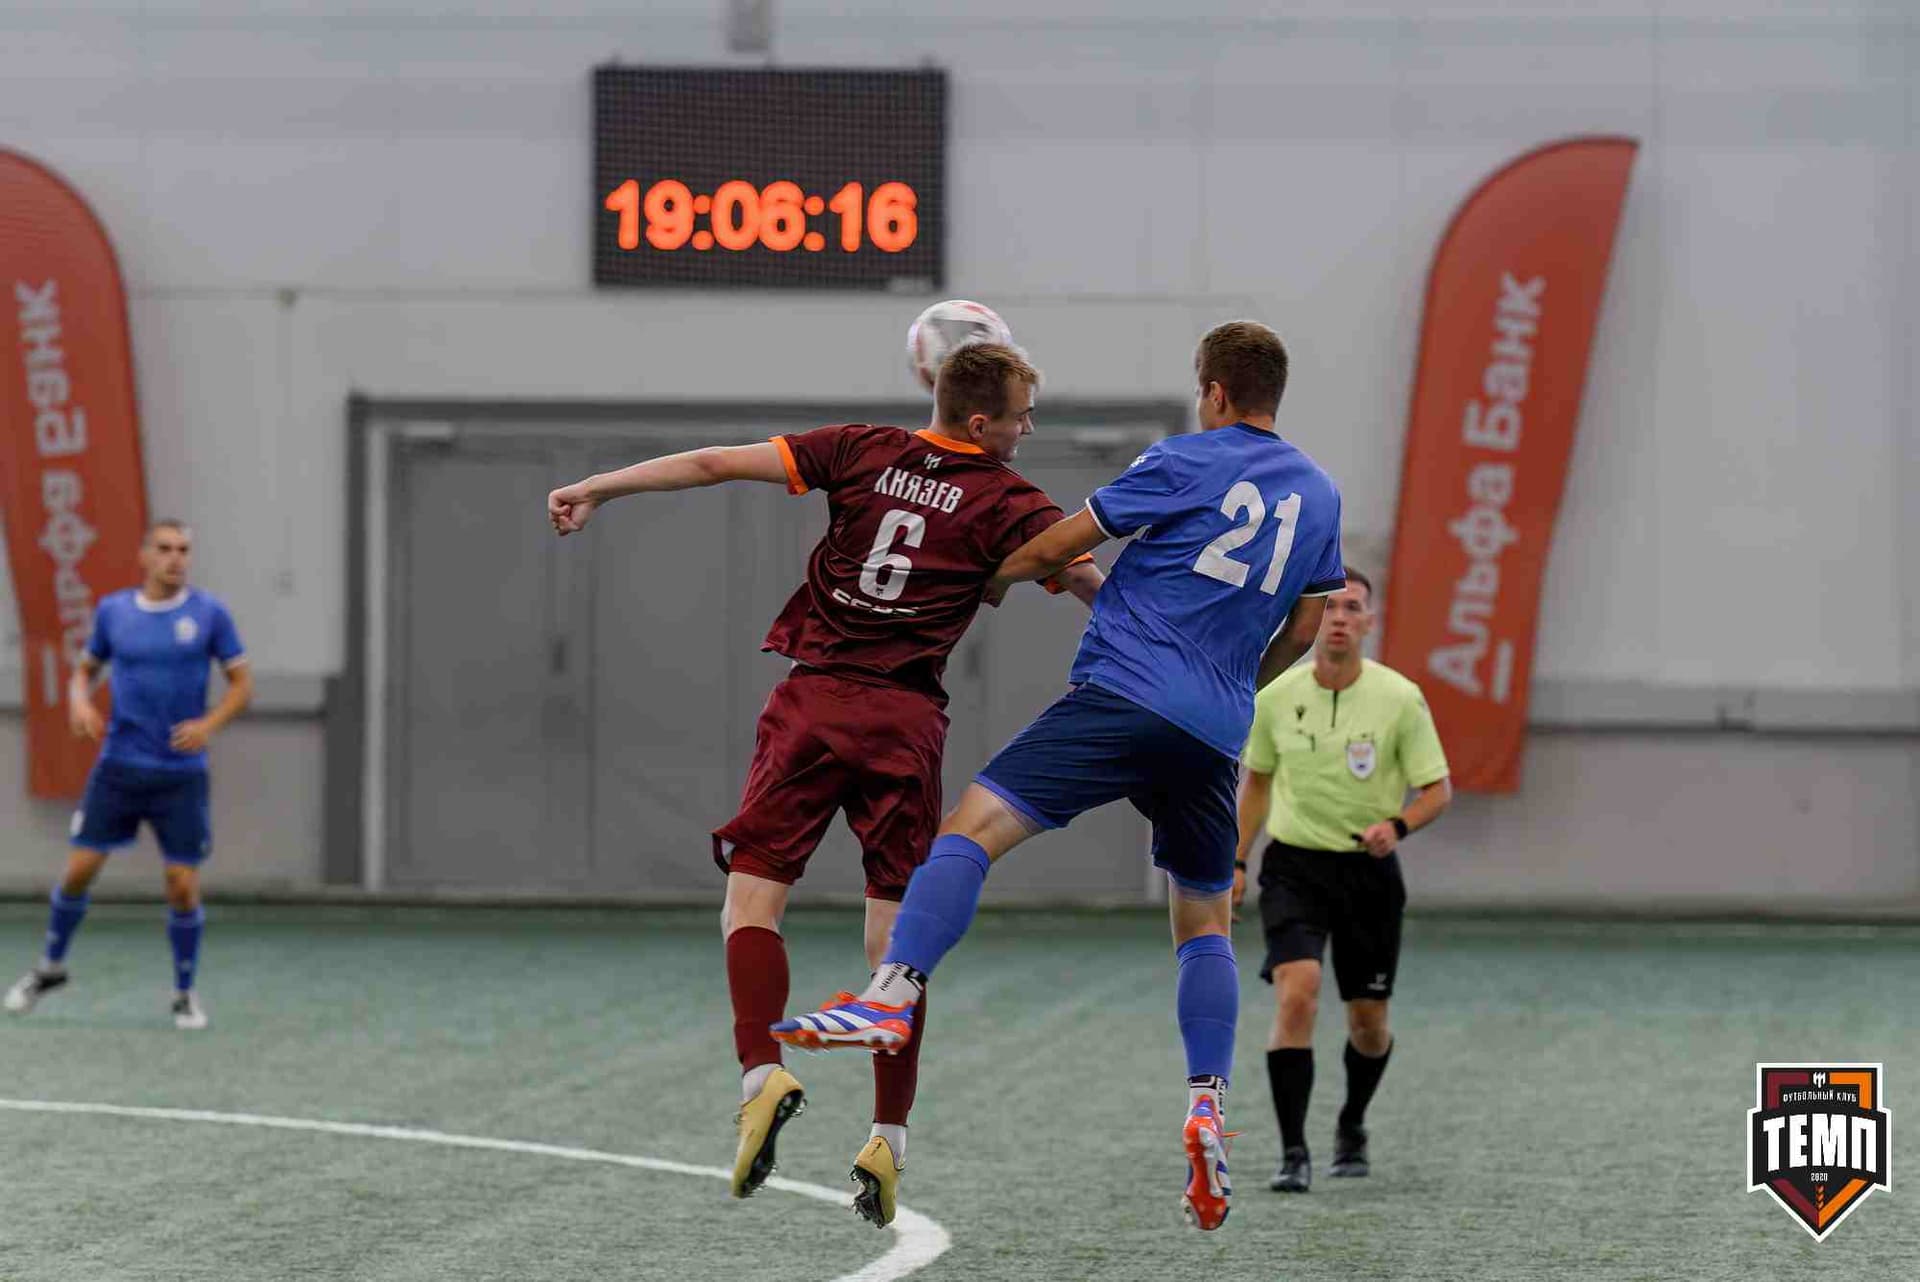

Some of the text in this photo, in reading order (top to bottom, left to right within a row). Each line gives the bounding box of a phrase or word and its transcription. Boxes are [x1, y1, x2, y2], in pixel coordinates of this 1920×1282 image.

[604, 179, 918, 252] 19:06:16
[1428, 272, 1547, 696] Альфа Банк
[858, 509, 926, 601] 6
[1192, 480, 1302, 596] 21
